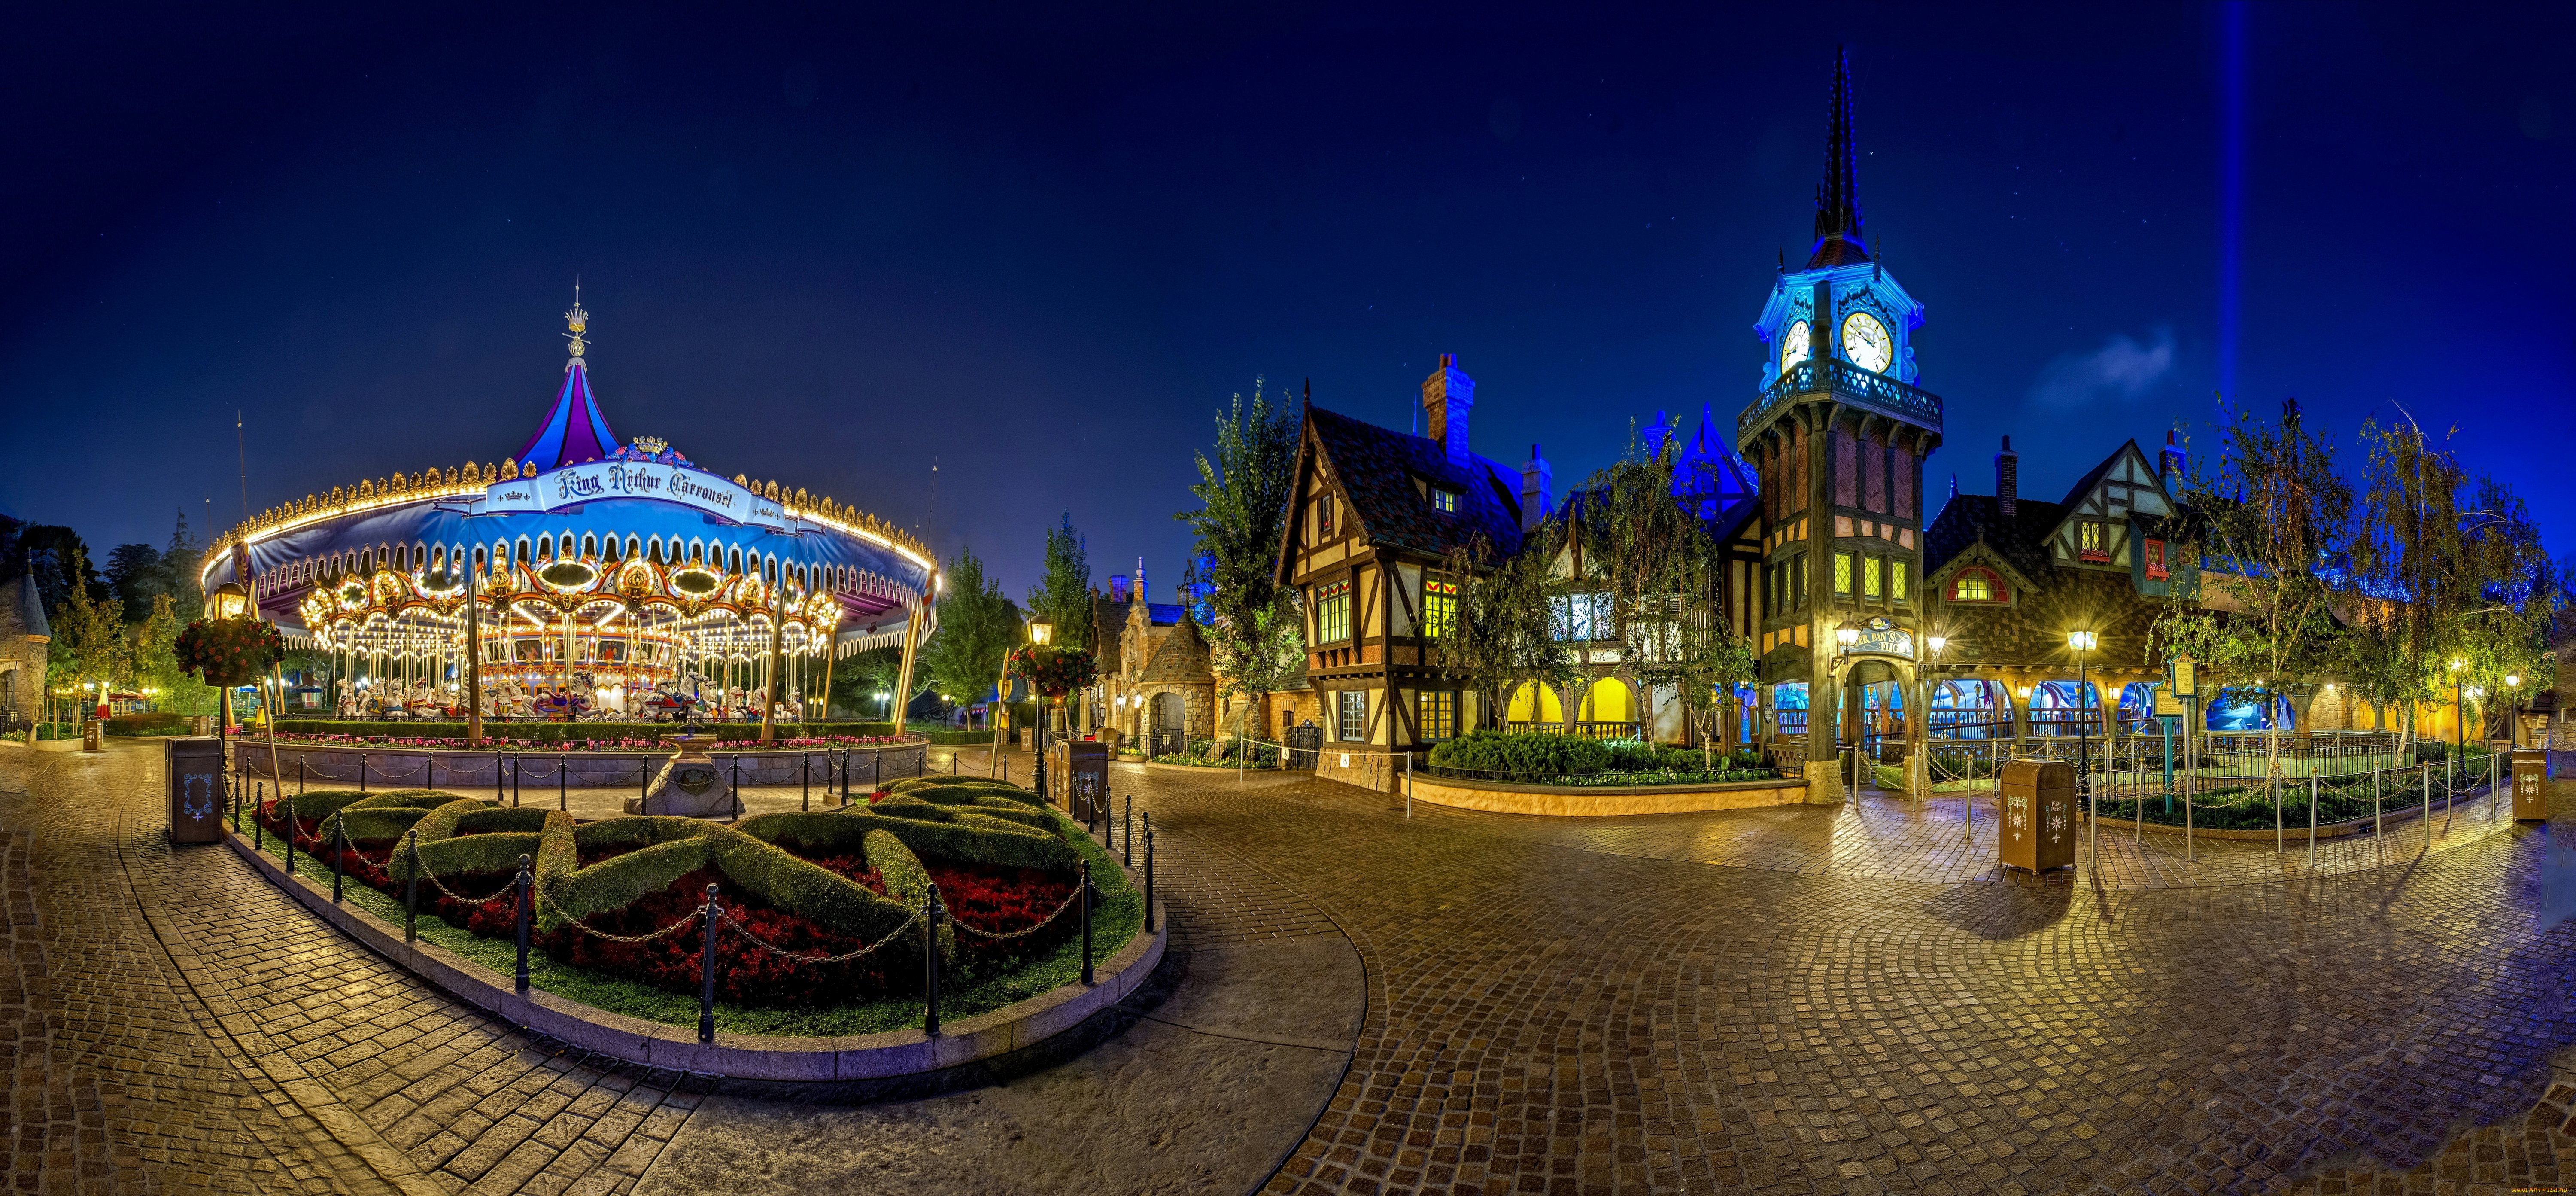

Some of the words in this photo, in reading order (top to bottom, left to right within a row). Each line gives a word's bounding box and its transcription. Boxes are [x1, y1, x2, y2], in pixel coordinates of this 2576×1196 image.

[554, 469, 604, 499] King
[608, 463, 661, 494] Arthur
[667, 470, 737, 508] Carrousel
[1871, 632, 1896, 643] PAN'S
